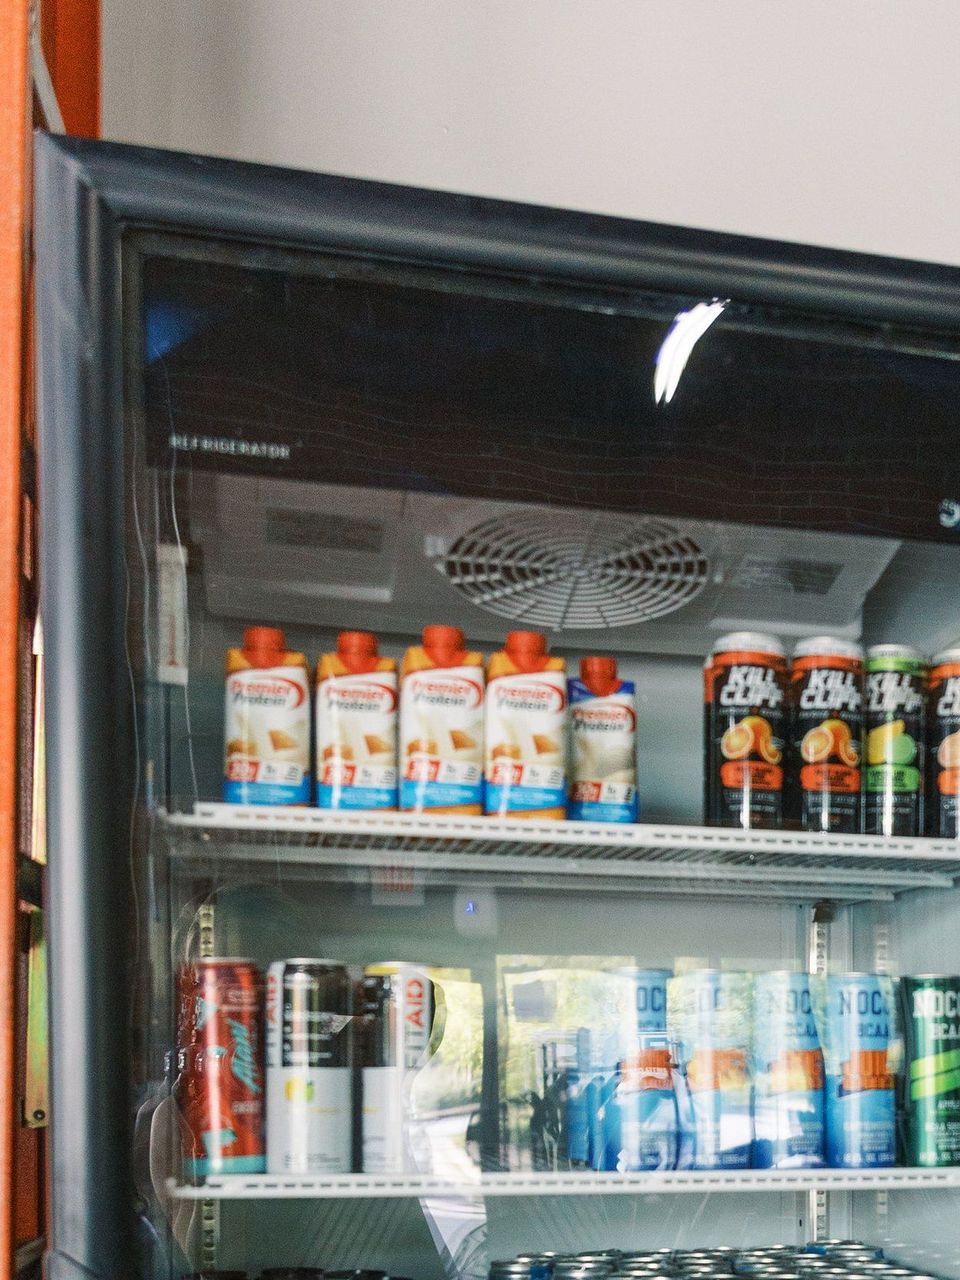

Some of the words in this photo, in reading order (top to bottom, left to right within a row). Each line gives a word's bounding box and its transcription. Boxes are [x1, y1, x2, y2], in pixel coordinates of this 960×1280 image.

[729, 666, 775, 688] KILL
[808, 669, 855, 690] KILL
[720, 682, 784, 708] CLIFF
